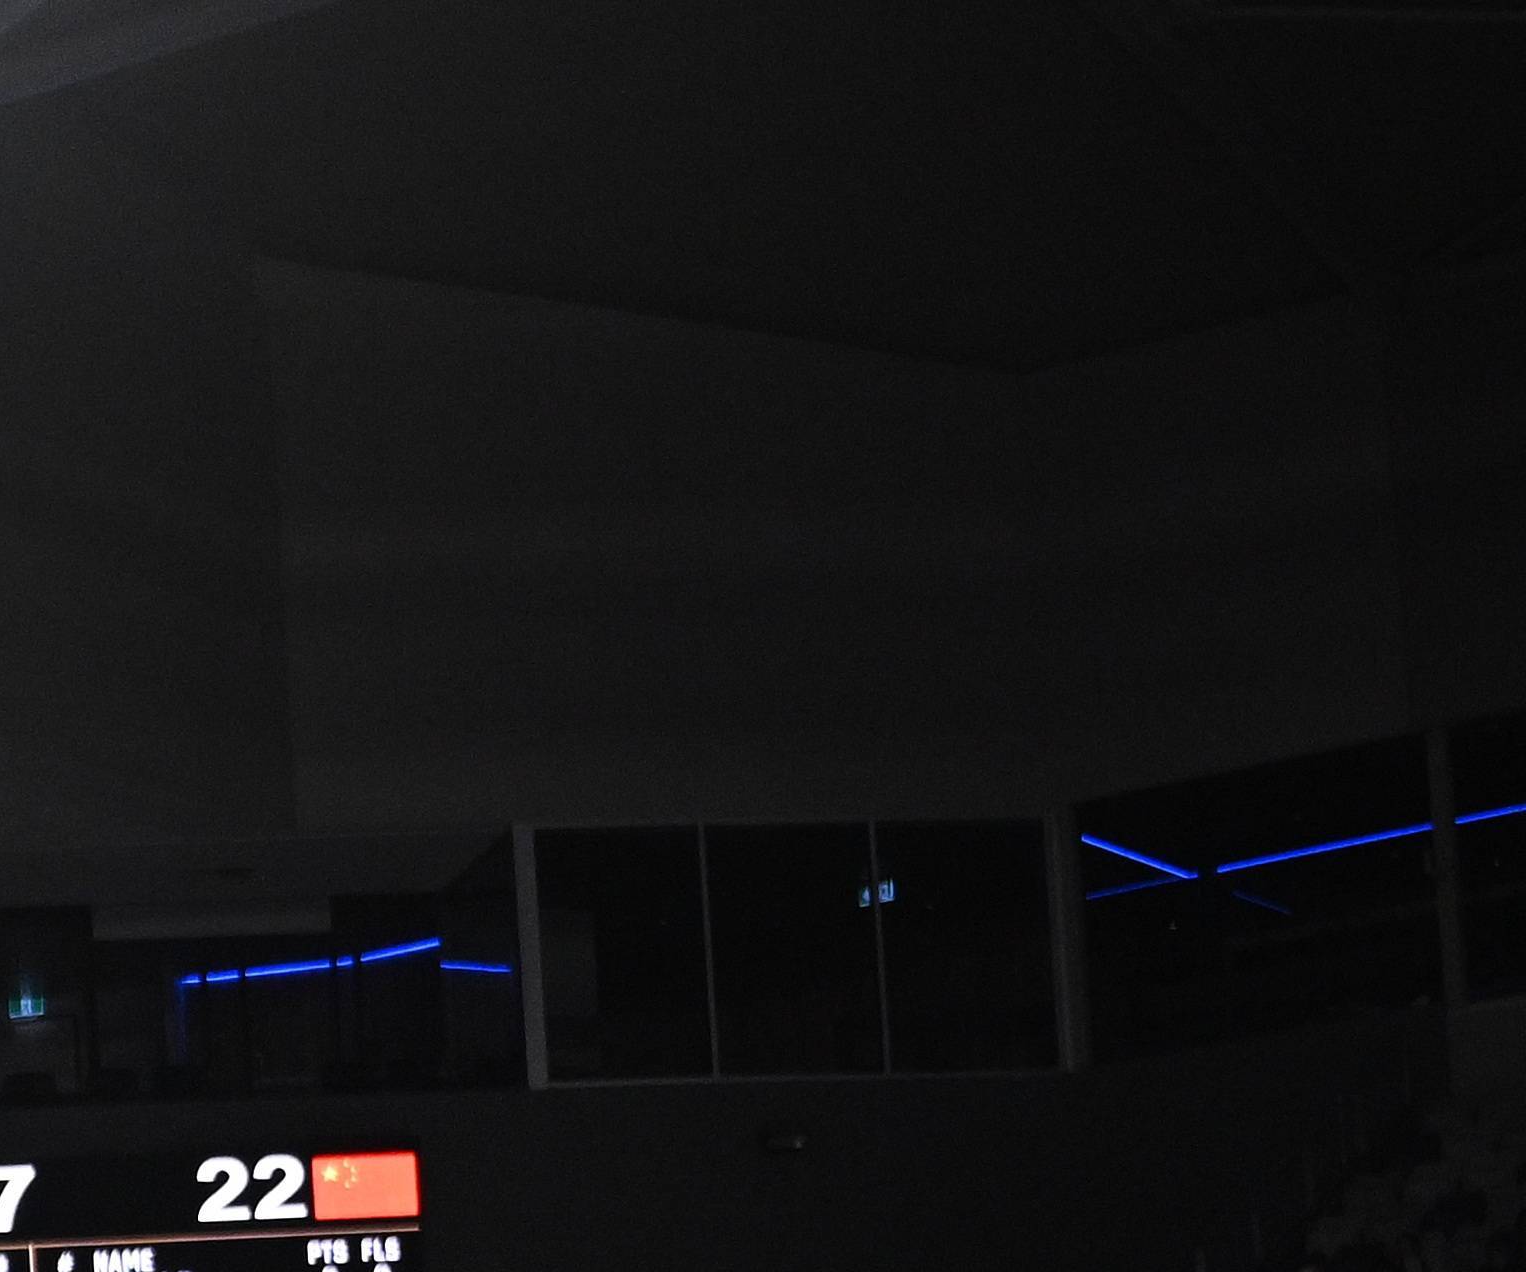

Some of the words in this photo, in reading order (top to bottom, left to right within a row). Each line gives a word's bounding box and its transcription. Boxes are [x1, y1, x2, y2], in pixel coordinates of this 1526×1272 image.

[196, 1154, 309, 1223] 22
[307, 1239, 349, 1265] PTS
[360, 1236, 401, 1262] FLS
